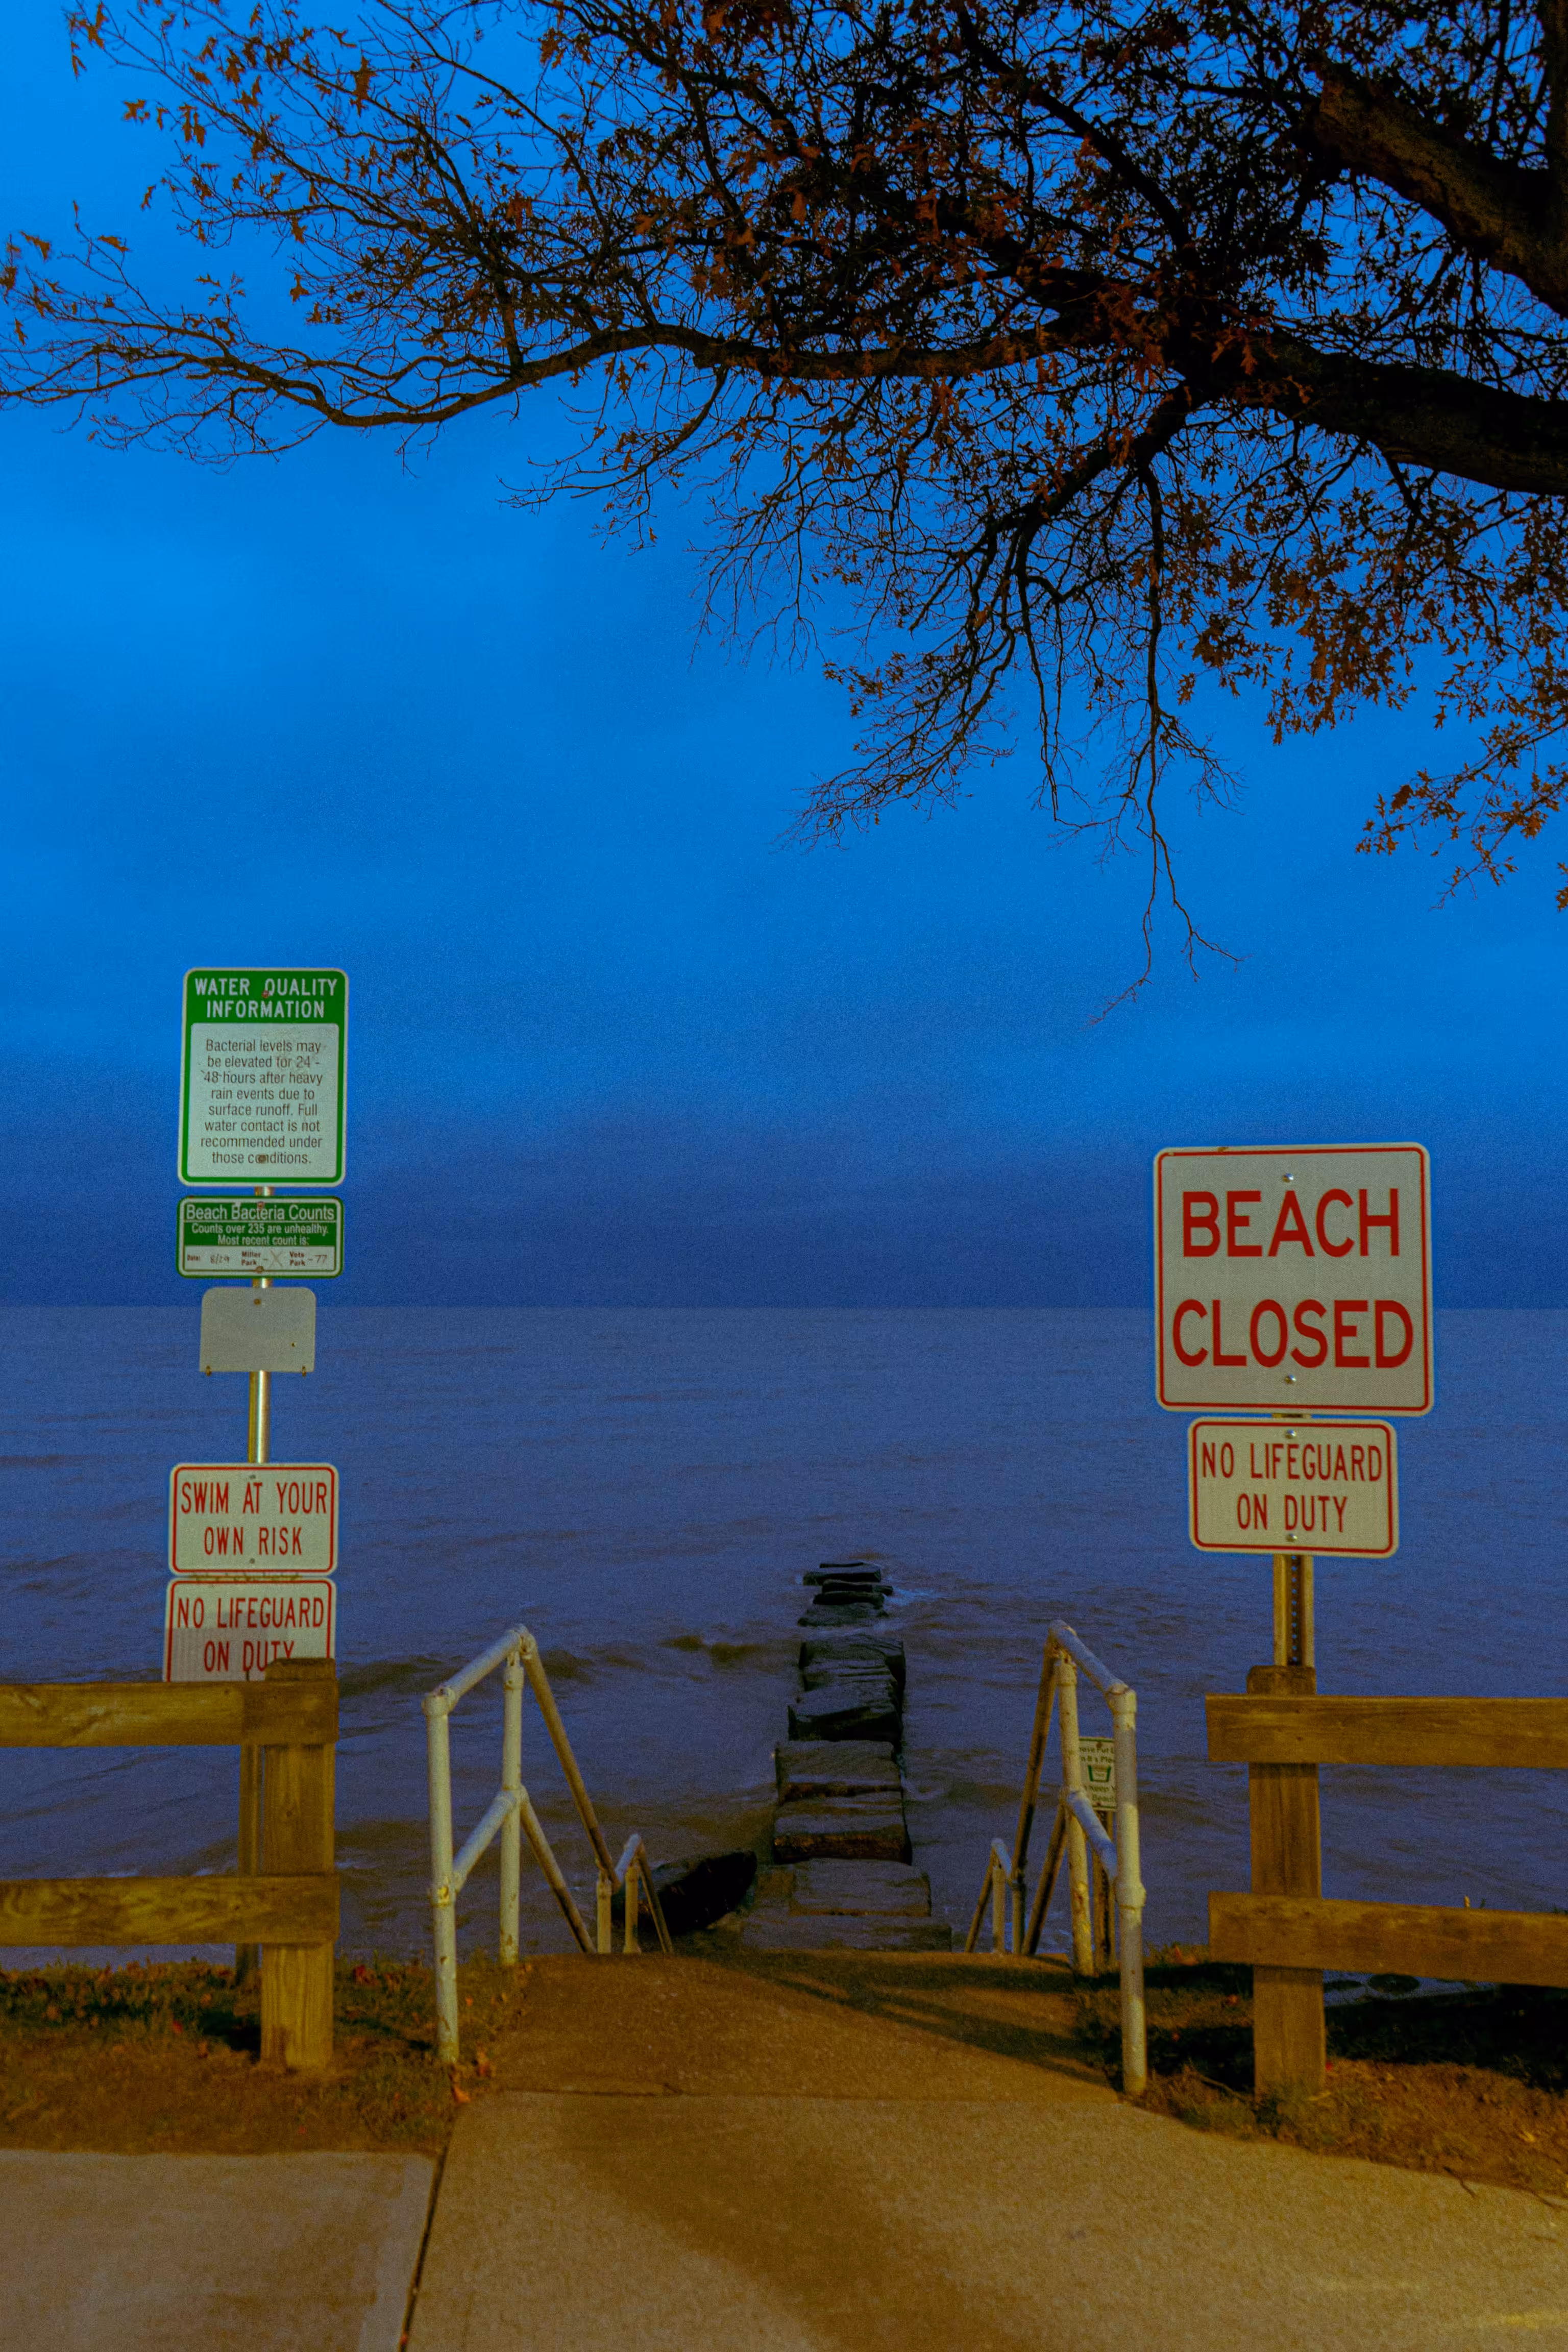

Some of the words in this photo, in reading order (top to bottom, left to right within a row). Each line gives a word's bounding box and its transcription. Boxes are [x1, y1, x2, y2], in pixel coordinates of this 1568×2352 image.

[194, 977, 251, 996] WATER
[264, 977, 337, 996] QUALITY
[206, 1000, 325, 1018] INFORMATION
[206, 1039, 255, 1052] Bacterial
[260, 1039, 292, 1052] levels
[297, 1042, 322, 1054] may
[207, 1055, 221, 1068] be
[225, 1056, 272, 1068] elevated
[276, 1056, 292, 1068] for
[296, 1056, 311, 1068] 24
[204, 1071, 218, 1084] 48
[223, 1071, 256, 1084] hours
[259, 1071, 285, 1084] after
[288, 1071, 323, 1087] heavy
[211, 1088, 232, 1100] rain
[237, 1088, 275, 1100] events
[278, 1087, 300, 1100] due
[304, 1088, 315, 1100] to
[208, 1103, 252, 1116] surface
[256, 1103, 293, 1116] runoff.
[298, 1103, 317, 1116] Full
[205, 1119, 237, 1132] water
[240, 1119, 284, 1132] contact
[287, 1119, 298, 1132] is
[301, 1120, 321, 1132] not
[201, 1136, 285, 1148] recommended
[289, 1136, 323, 1148] under
[212, 1152, 244, 1164] those
[186, 1204, 228, 1220] Beach
[231, 1204, 285, 1220] Bacteria
[289, 1204, 335, 1220] Counts
[191, 1223, 224, 1234] Counts
[226, 1224, 246, 1234] over
[248, 1223, 264, 1234] 235
[267, 1225, 282, 1234] are
[284, 1223, 329, 1236] unhealthy.
[1182, 1188, 1400, 1258] BEACH
[217, 1234, 239, 1245] Most
[241, 1235, 271, 1245] recent
[272, 1235, 297, 1246] count
[1171, 1298, 1414, 1369] CLOSED
[1201, 1441, 1234, 1479] NO
[1250, 1442, 1383, 1482] LIFEGUARD
[181, 1482, 229, 1514] SWIM
[242, 1482, 263, 1514] AT
[276, 1482, 327, 1514] YOUR
[1237, 1493, 1268, 1531] ON
[1284, 1494, 1348, 1533] DUTY
[204, 1527, 244, 1556] OWN
[258, 1527, 302, 1556] RISK
[177, 1597, 205, 1628] NO
[216, 1597, 324, 1628] LIFEGUARD
[204, 1640, 230, 1672] ON
[242, 1640, 295, 1672] DUTY
